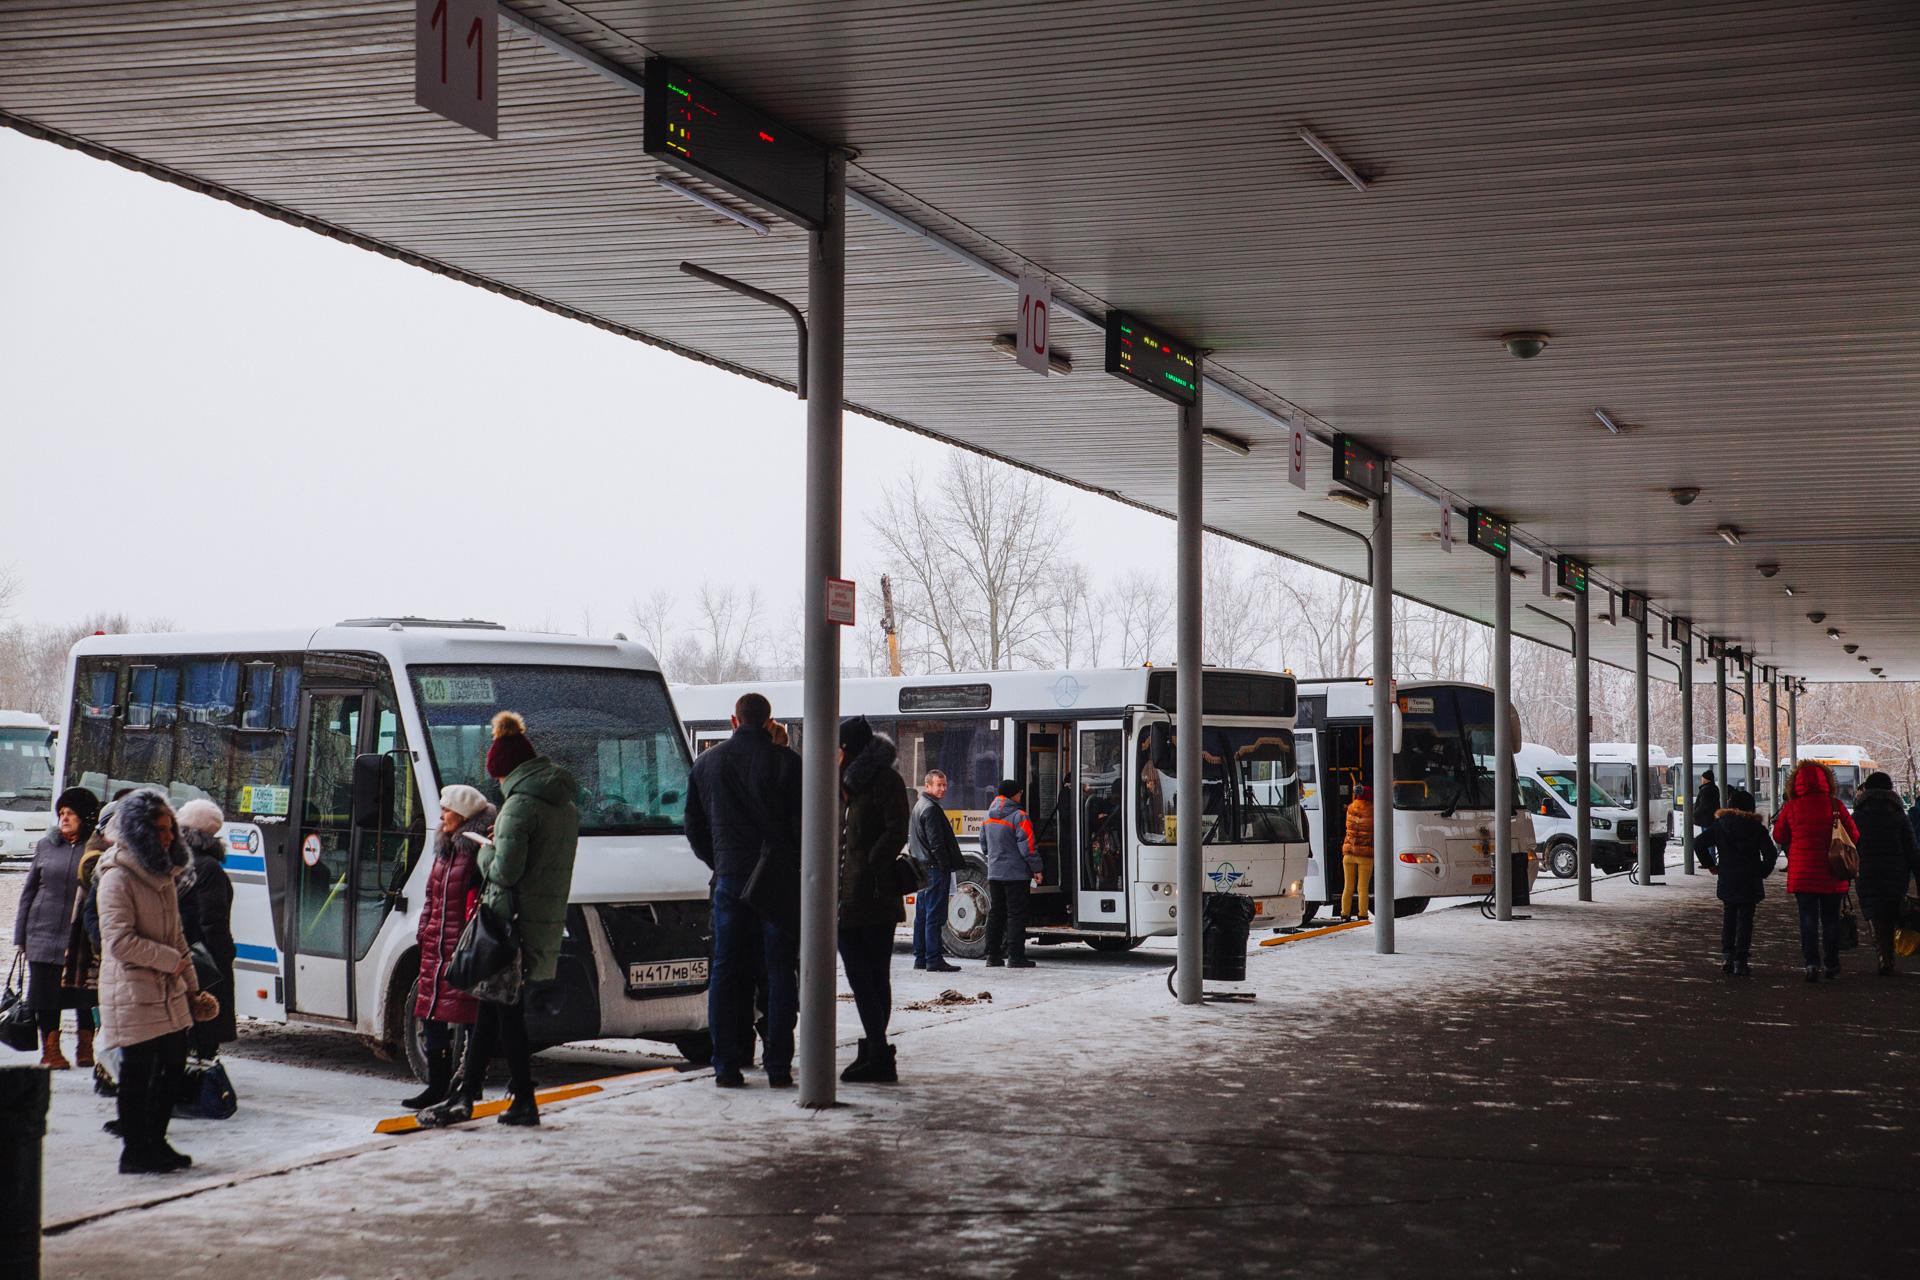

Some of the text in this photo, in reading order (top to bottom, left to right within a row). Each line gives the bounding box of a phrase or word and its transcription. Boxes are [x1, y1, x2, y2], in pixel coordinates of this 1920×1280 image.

[431, 0, 483, 101] 11
[1022, 294, 1046, 355] 10
[1294, 431, 1302, 473] 9
[692, 962, 704, 974] 45
